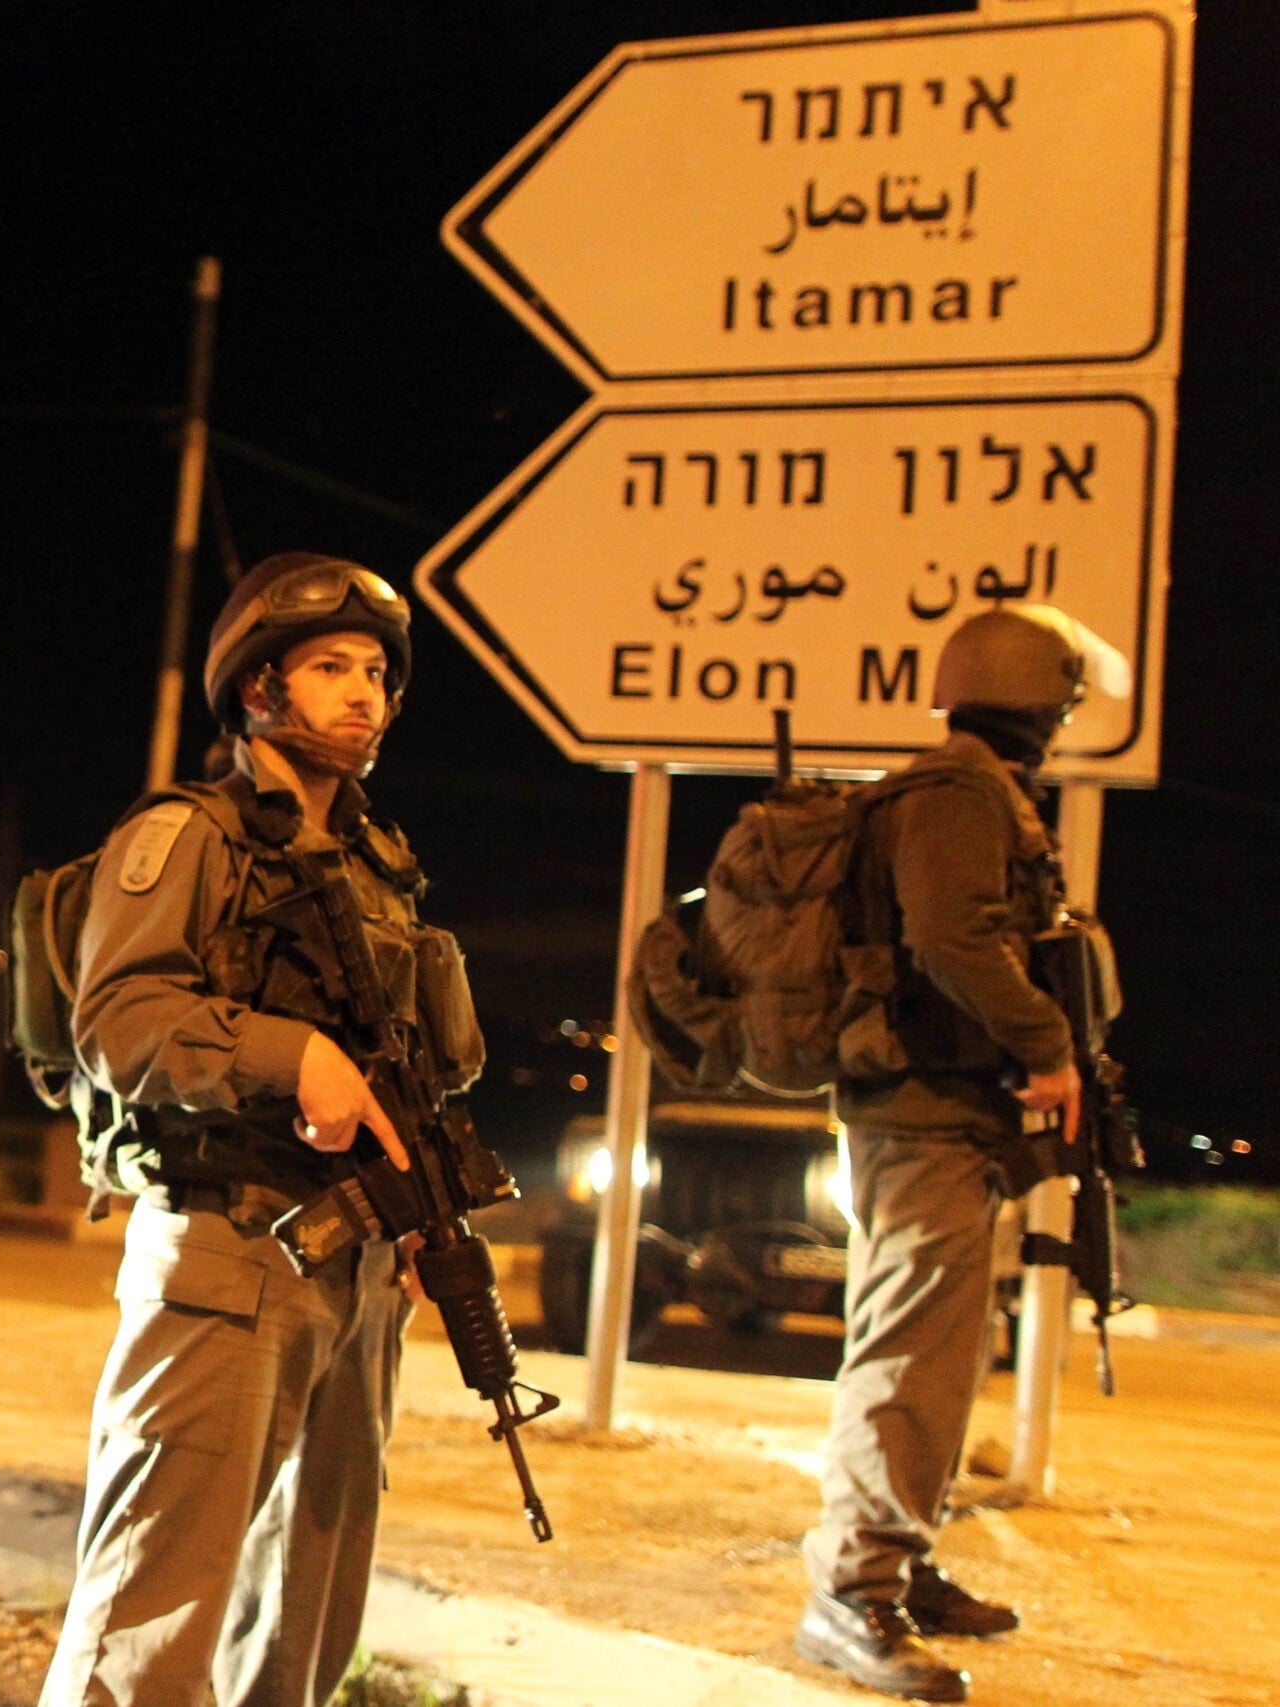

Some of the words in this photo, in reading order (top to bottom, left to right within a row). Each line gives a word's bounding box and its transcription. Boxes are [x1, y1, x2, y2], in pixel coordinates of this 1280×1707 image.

[740, 75, 1017, 144] איתמר
[764, 168, 978, 254] إيتامار
[723, 276, 1019, 332] Itamar
[623, 449, 828, 508] מורה
[894, 435, 1098, 516] אלון
[652, 558, 848, 625] موري
[610, 643, 798, 702] Elon
